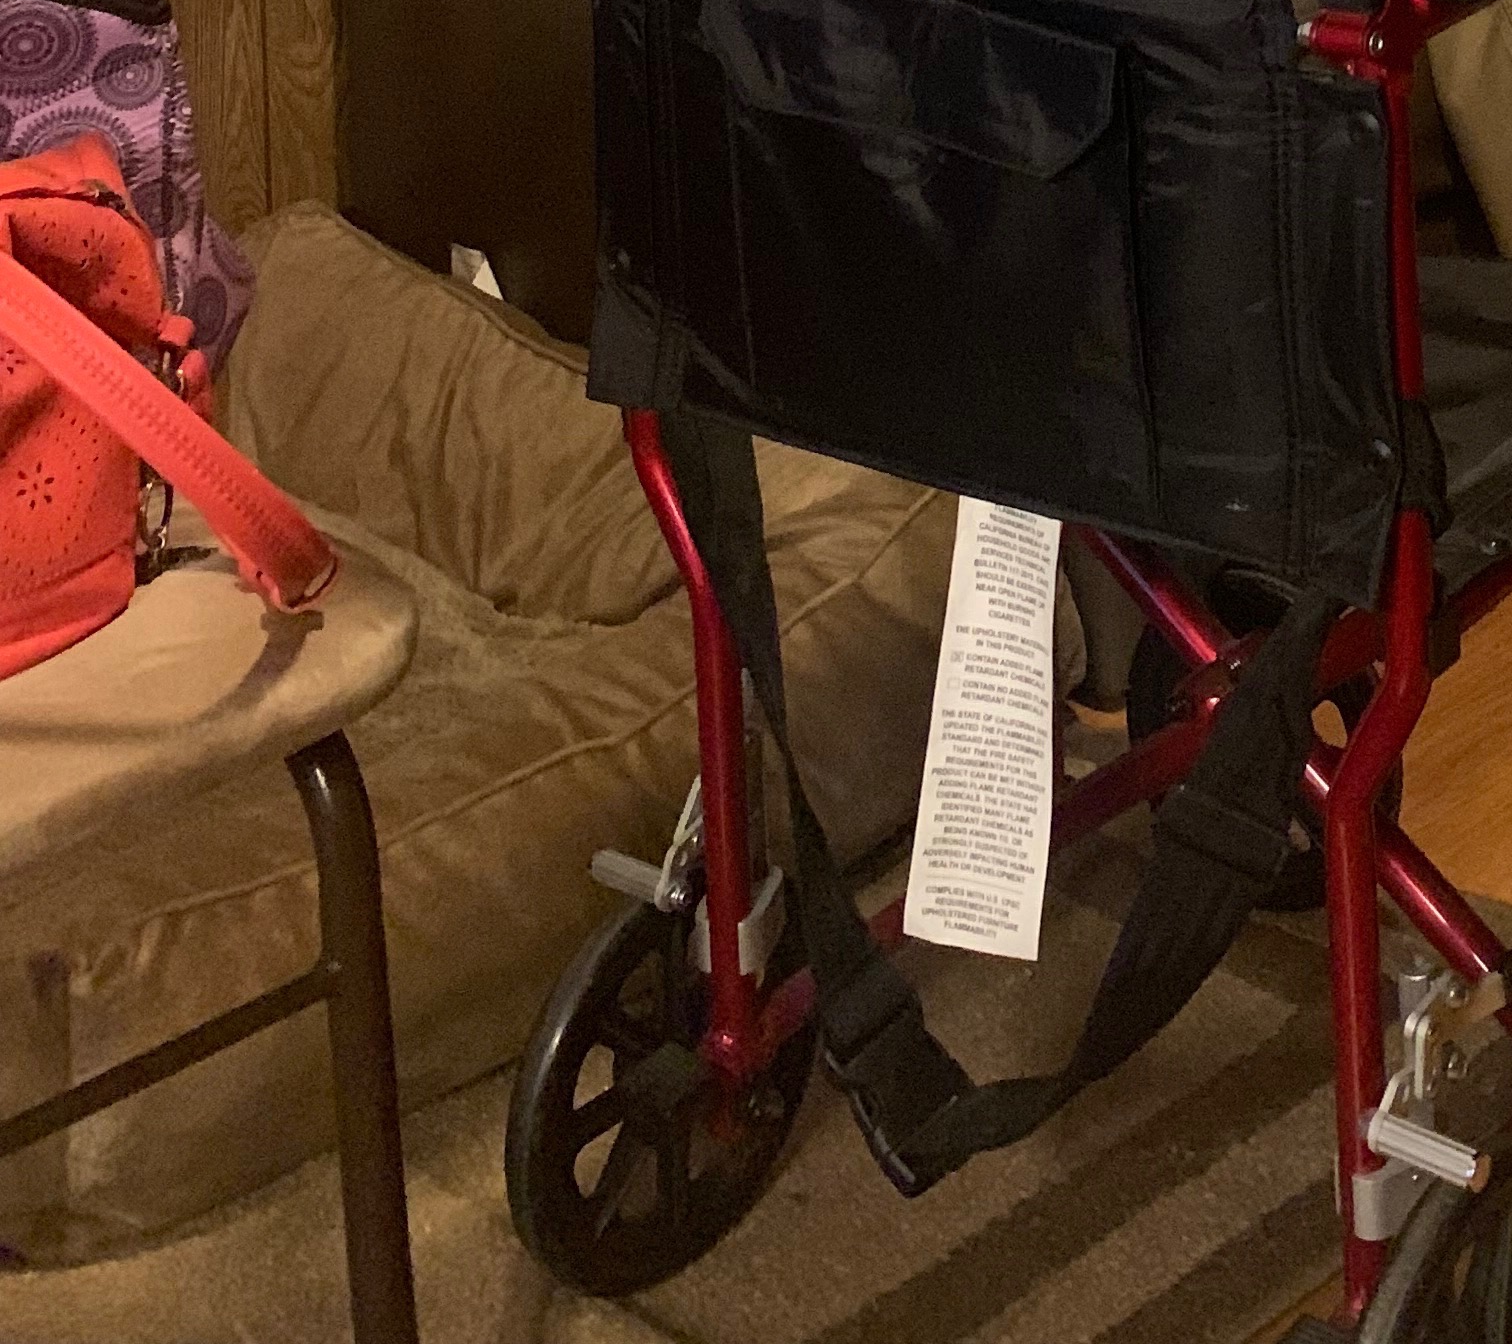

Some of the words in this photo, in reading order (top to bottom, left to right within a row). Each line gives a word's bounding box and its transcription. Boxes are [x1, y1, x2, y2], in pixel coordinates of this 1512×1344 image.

[979, 522, 1017, 539] CALIFORNIA
[977, 535, 1017, 551] HOUSEHOLD
[974, 559, 1008, 571] BULLETIN
[976, 583, 996, 593] NEAR
[998, 588, 1016, 598] OPEN
[988, 598, 1006, 607] WITH
[972, 628, 1019, 641] UPHOLSTERY
[986, 640, 1002, 650] THIS
[966, 653, 999, 664] CONTAIN
[962, 680, 995, 691] CONTAIN
[997, 685, 1008, 694] NO
[958, 710, 981, 720] STATE
[981, 725, 995, 734] THE
[952, 744, 971, 754] THAT
[974, 748, 988, 757] THE
[990, 751, 1006, 759] FIRE
[932, 768, 968, 777] PRODUCT
[970, 770, 986, 779] CAN
[1006, 765, 1021, 774] FOR
[970, 782, 994, 792] FLAME
[1000, 799, 1022, 810] STATE
[984, 807, 1005, 817] MANY
[1007, 812, 1030, 824] FLAME
[934, 814, 980, 824] RETARDANT
[981, 819, 1023, 834] CHEMICALS
[1024, 830, 1034, 838] AS
[928, 860, 959, 869] HEALTH
[1010, 863, 1035, 874] HUMAN
[967, 890, 985, 901] WITH
